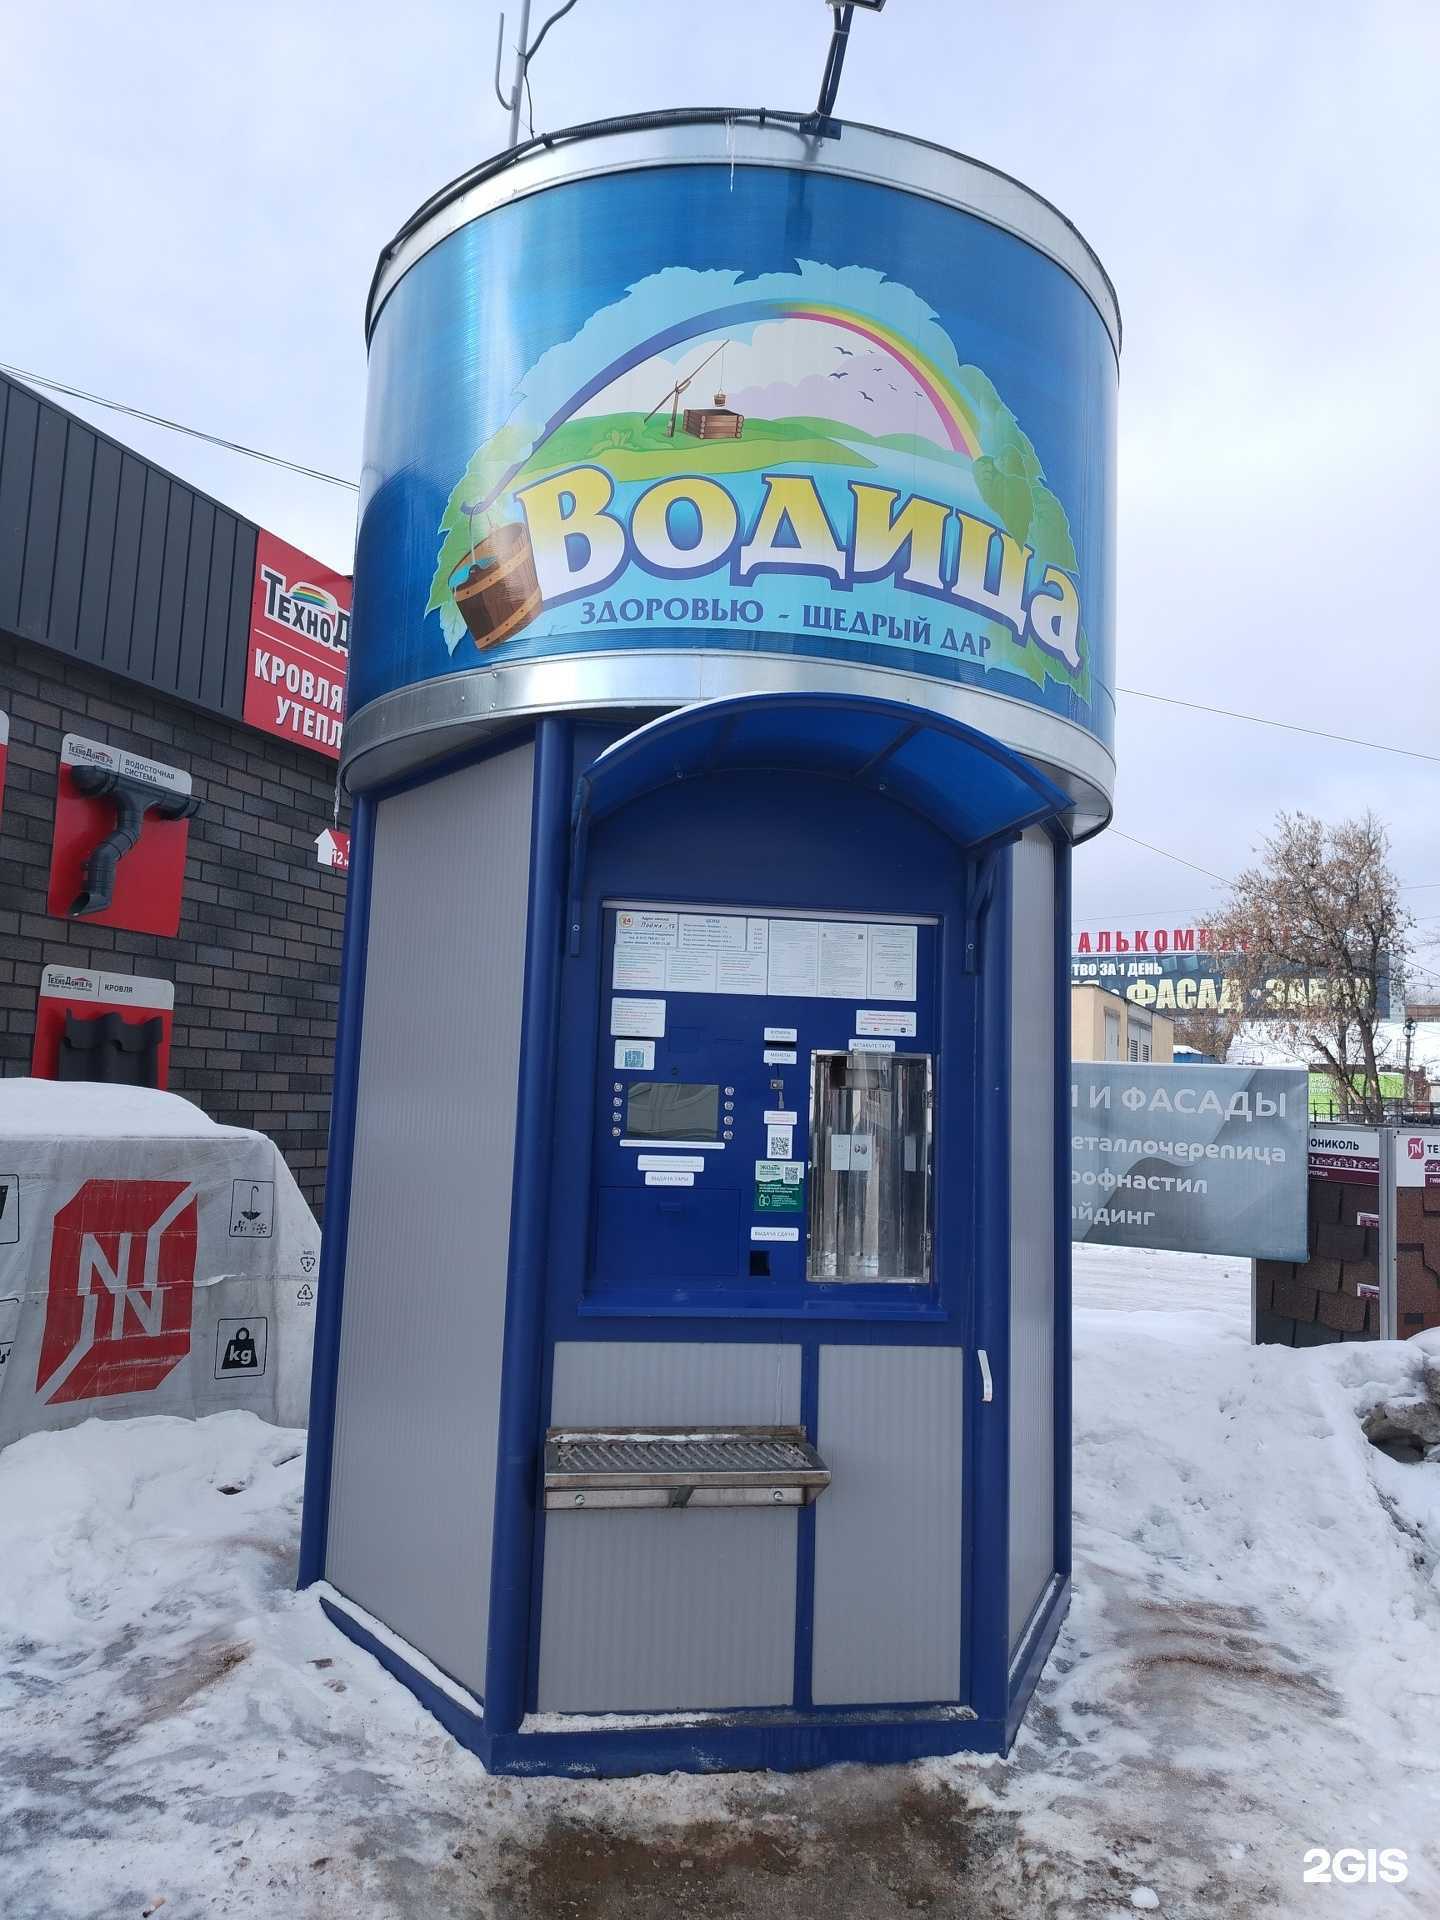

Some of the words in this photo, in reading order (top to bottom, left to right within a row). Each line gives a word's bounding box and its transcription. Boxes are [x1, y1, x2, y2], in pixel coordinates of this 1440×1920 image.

[580, 598, 764, 625] ЗДОРОВЬЮ
[802, 604, 931, 645] ЩЕДРЫЙ
[941, 628, 991, 657] ДАР
[255, 648, 343, 713] КРОВЛЯ
[275, 695, 343, 750] УТЕПЛ
[124, 767, 157, 782] СИСТЕМА
[125, 759, 175, 780] ВОДОСТОЧНАЯ
[1100, 963, 1117, 976] ЗА
[1118, 964, 1125, 976] 1
[1128, 962, 1163, 977] ДЕНЬ
[104, 984, 133, 993] КРОВЛЯ
[1127, 978, 1244, 1013] ФАСАД
[1089, 1086, 1111, 1109] И
[1121, 1087, 1286, 1122] ФАСАДЫ
[1072, 1136, 1286, 1165] еталлочерепица
[1309, 1138, 1360, 1151] ОНИКОЛЬ
[229, 1344, 252, 1364] kg
